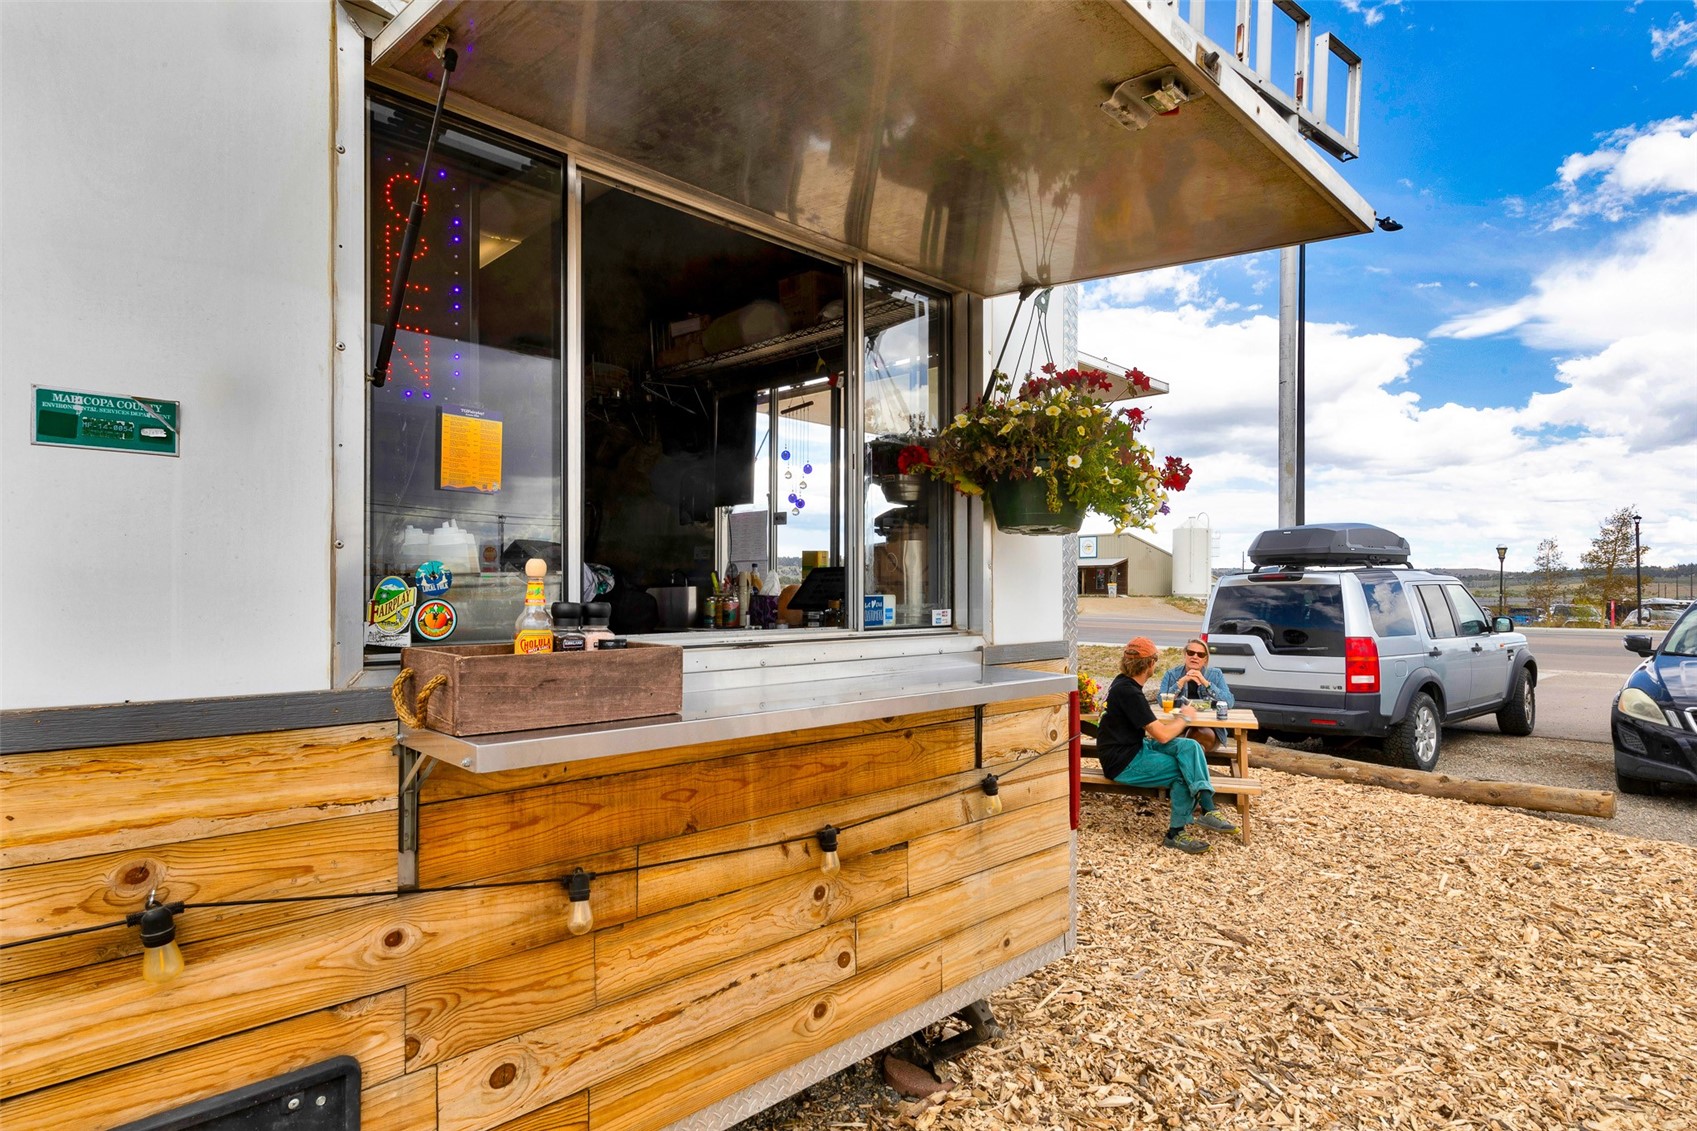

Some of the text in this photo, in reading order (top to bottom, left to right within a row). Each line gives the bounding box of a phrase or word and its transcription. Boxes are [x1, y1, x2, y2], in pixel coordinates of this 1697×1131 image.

[42, 401, 97, 412] ENVIRONNTAL
[130, 410, 171, 420] DEPARNT
[368, 589, 412, 626] FAIRPLAY
[520, 638, 551, 653] CHOLULA
